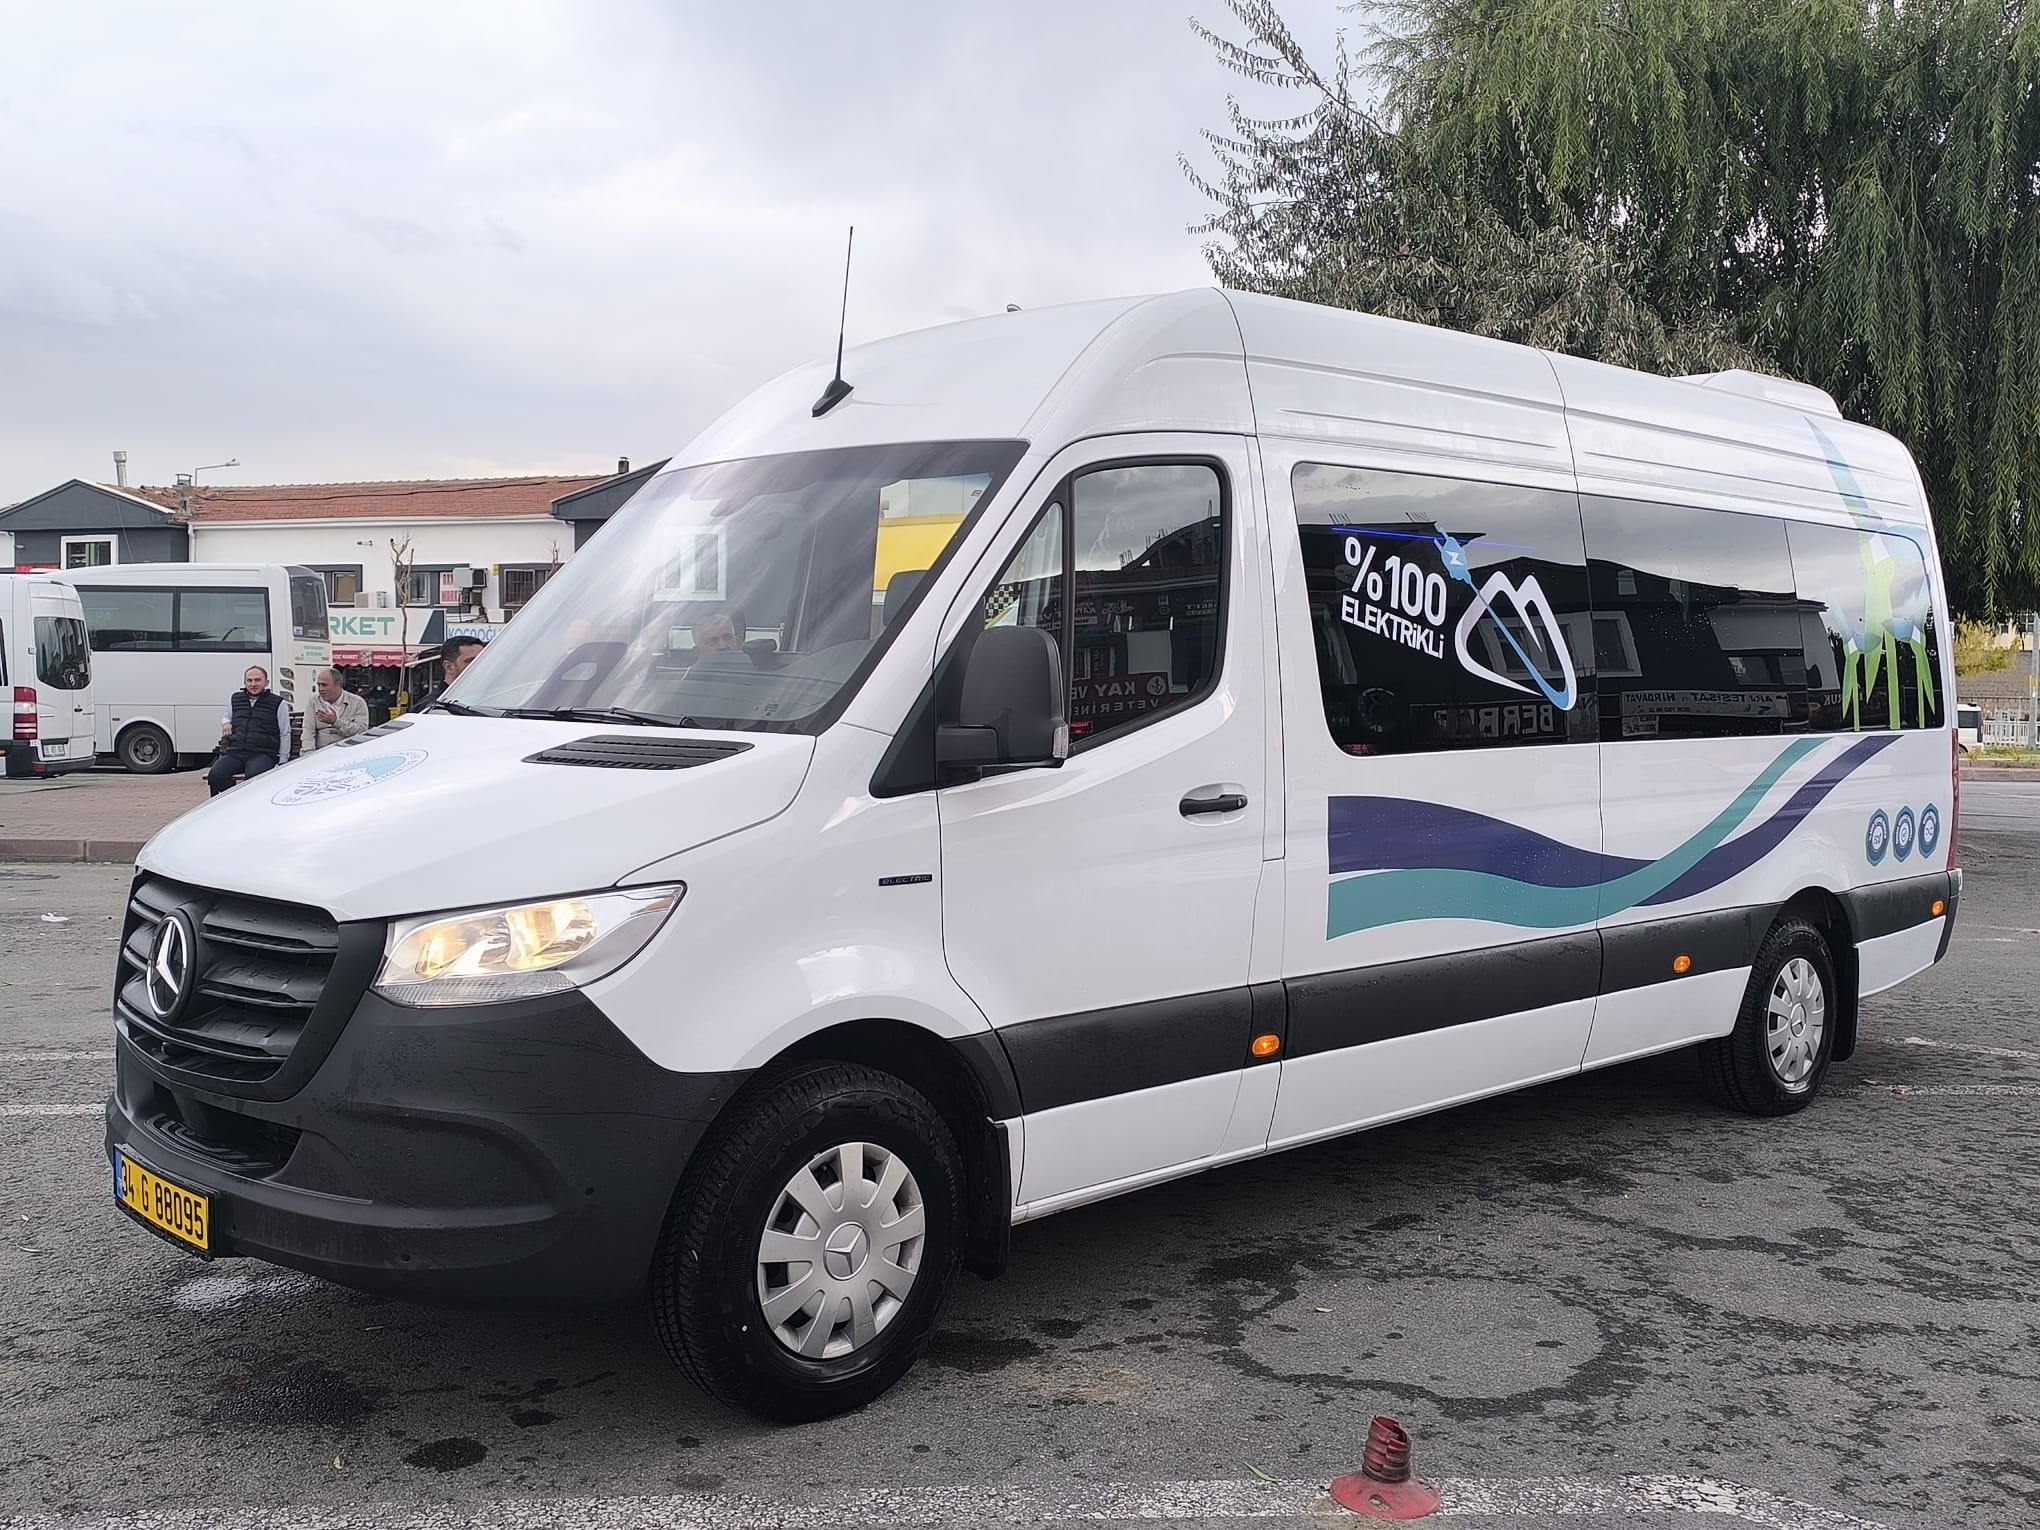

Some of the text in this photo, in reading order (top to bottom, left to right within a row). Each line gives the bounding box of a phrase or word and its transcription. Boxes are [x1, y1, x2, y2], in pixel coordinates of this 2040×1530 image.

[1344, 536, 1447, 627] %100
[121, 1159, 204, 1241] 34 G 88095
